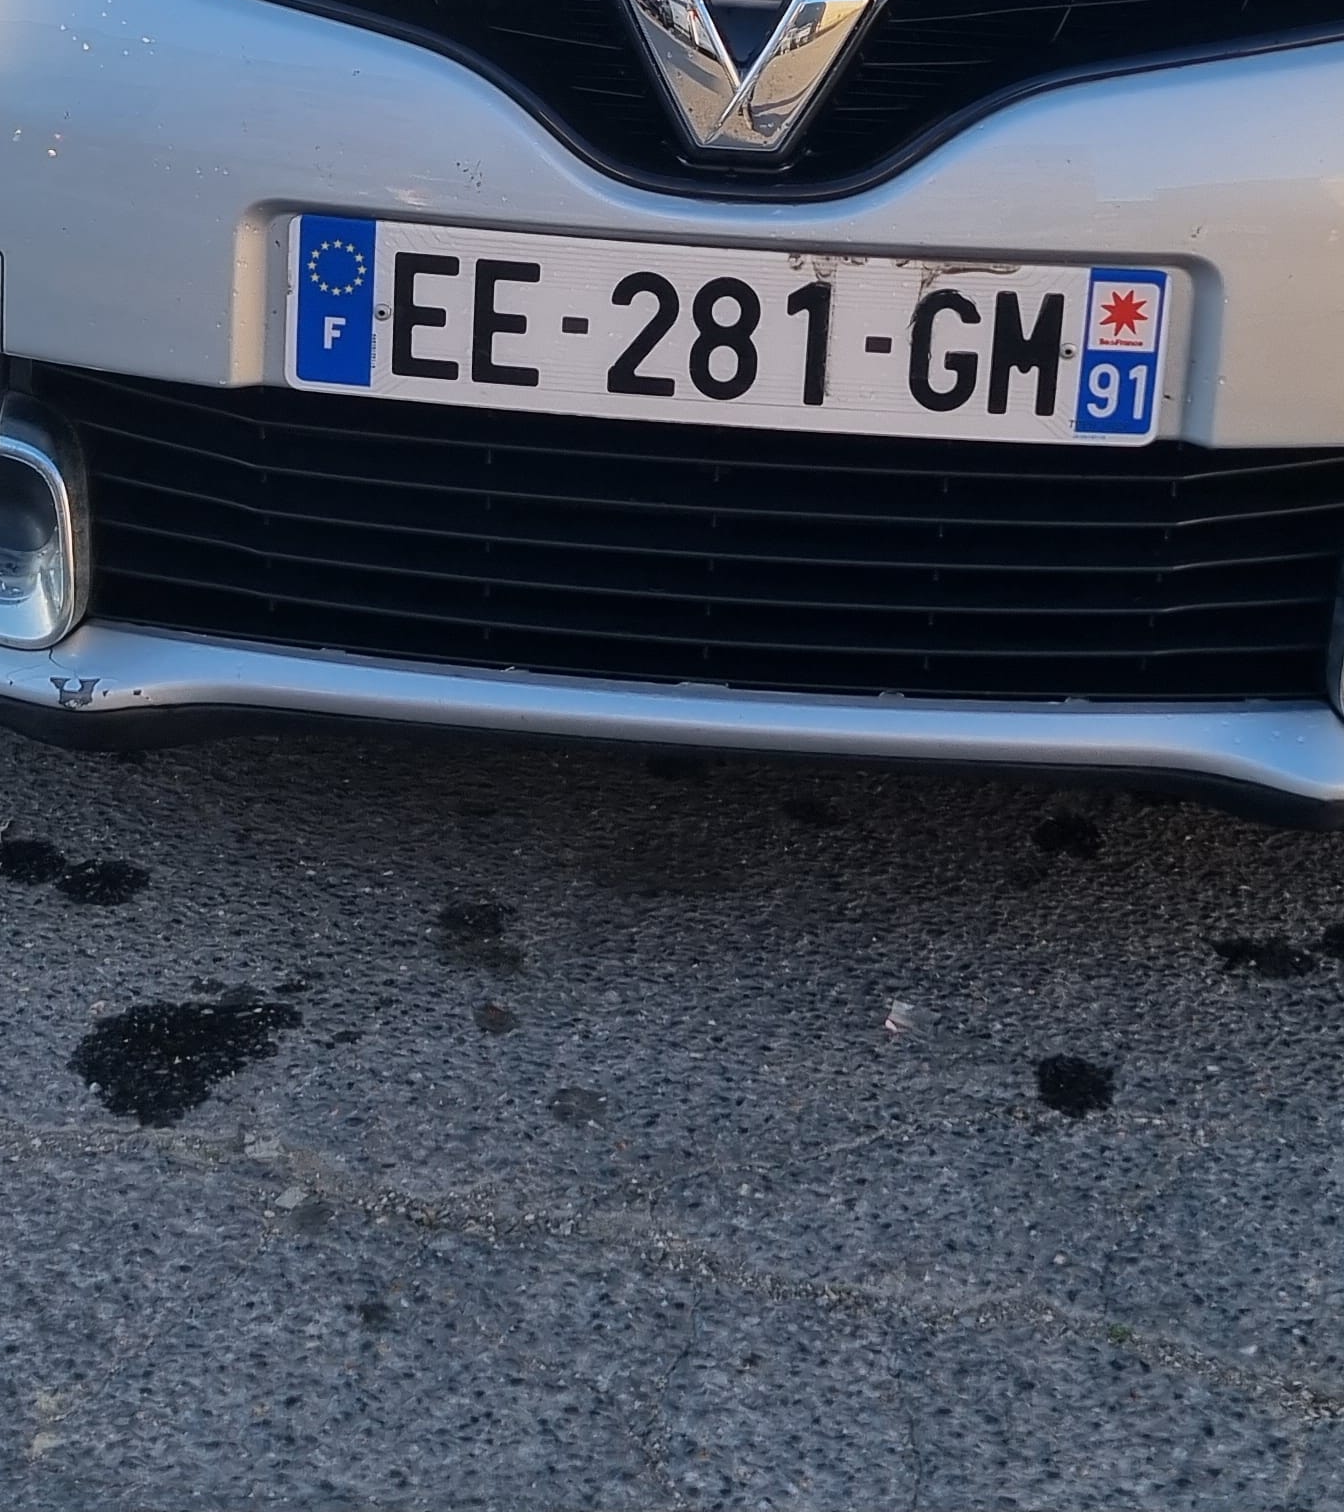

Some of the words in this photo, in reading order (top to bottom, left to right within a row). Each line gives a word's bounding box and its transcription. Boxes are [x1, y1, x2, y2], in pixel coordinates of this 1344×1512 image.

[323, 316, 347, 350] F
[391, 251, 1065, 417] EE-281-GM
[1086, 362, 1149, 420] 91
